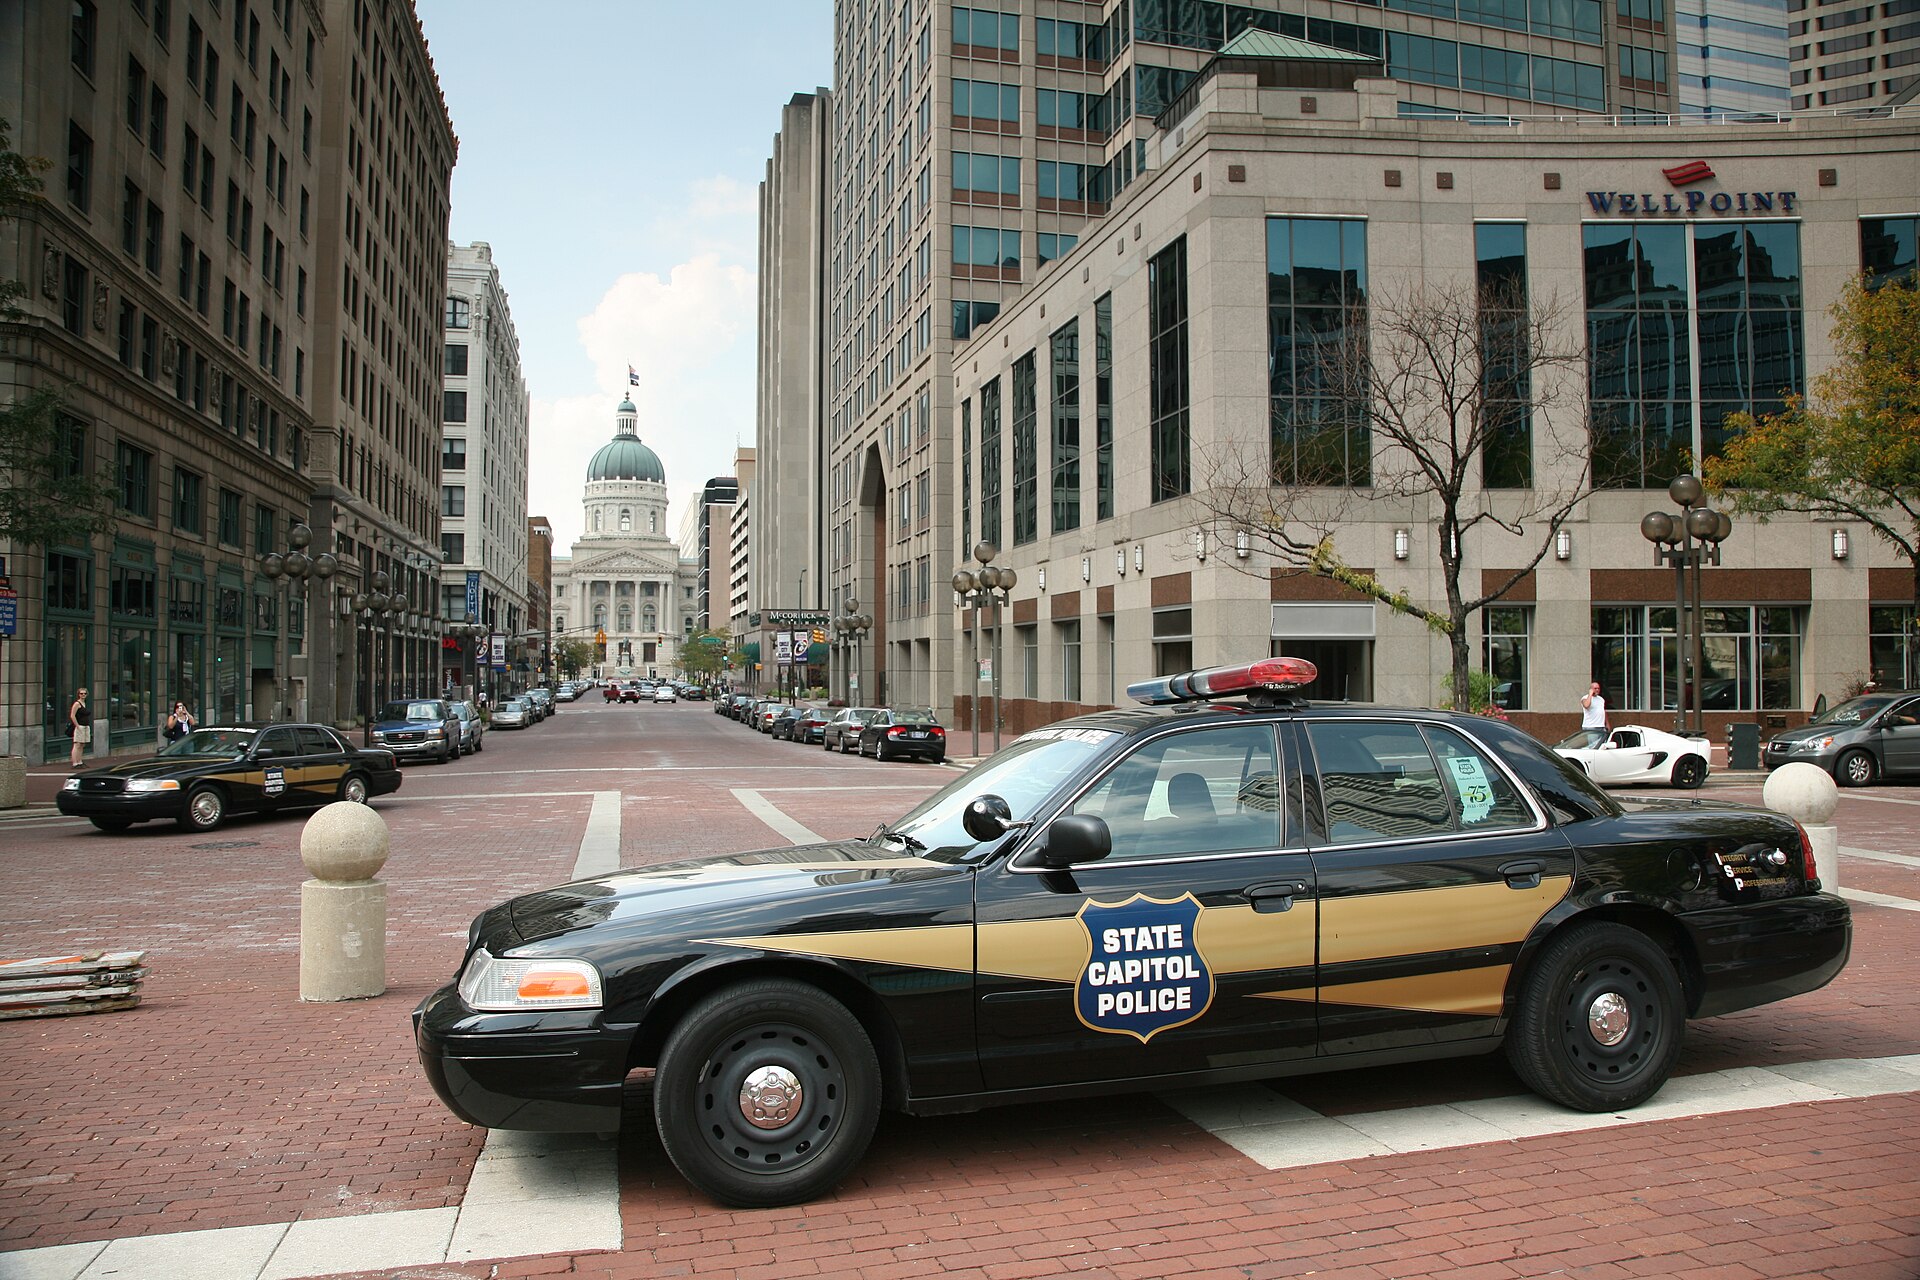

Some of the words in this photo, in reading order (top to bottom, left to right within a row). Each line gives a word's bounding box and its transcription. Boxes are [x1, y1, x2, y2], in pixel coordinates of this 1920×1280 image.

[1468, 785, 1487, 803] 75
[1723, 864, 1753, 878] SERVICE
[1102, 924, 1183, 954] STATE
[1088, 955, 1200, 986] CAPITOL
[1097, 986, 1191, 1017] POLICE
